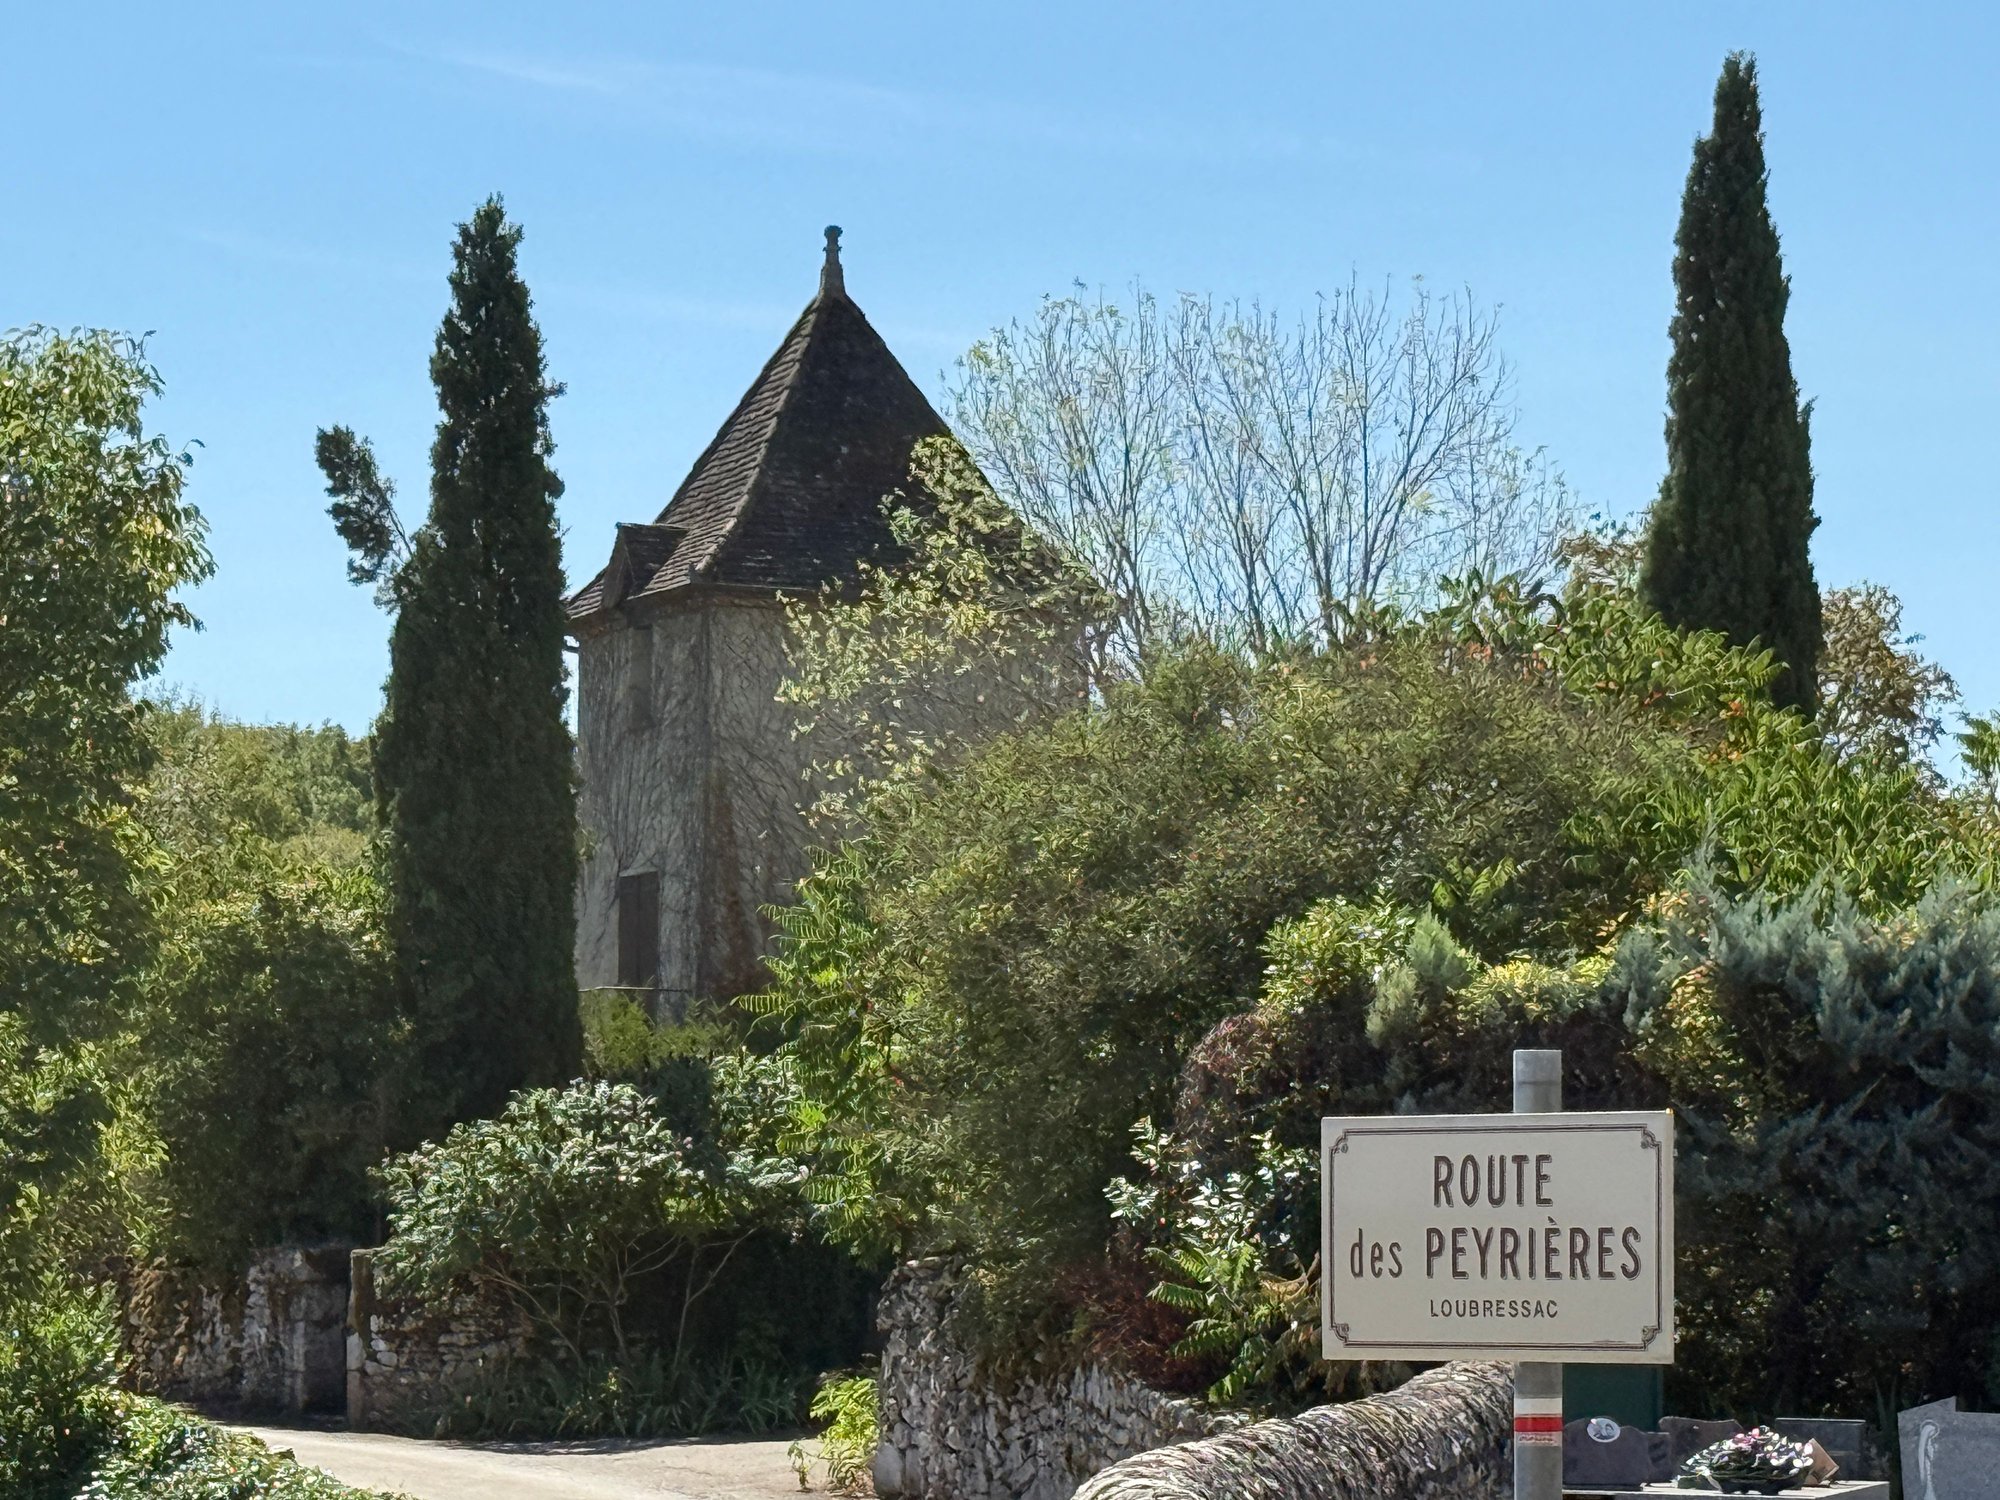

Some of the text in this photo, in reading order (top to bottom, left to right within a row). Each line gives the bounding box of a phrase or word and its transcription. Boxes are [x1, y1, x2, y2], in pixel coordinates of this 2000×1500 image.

[1433, 1154, 1554, 1207] ROUTE
[1350, 1217, 1642, 1280] des PEYRIÈRES
[1430, 1299, 1559, 1318] LOUBRESSAC
